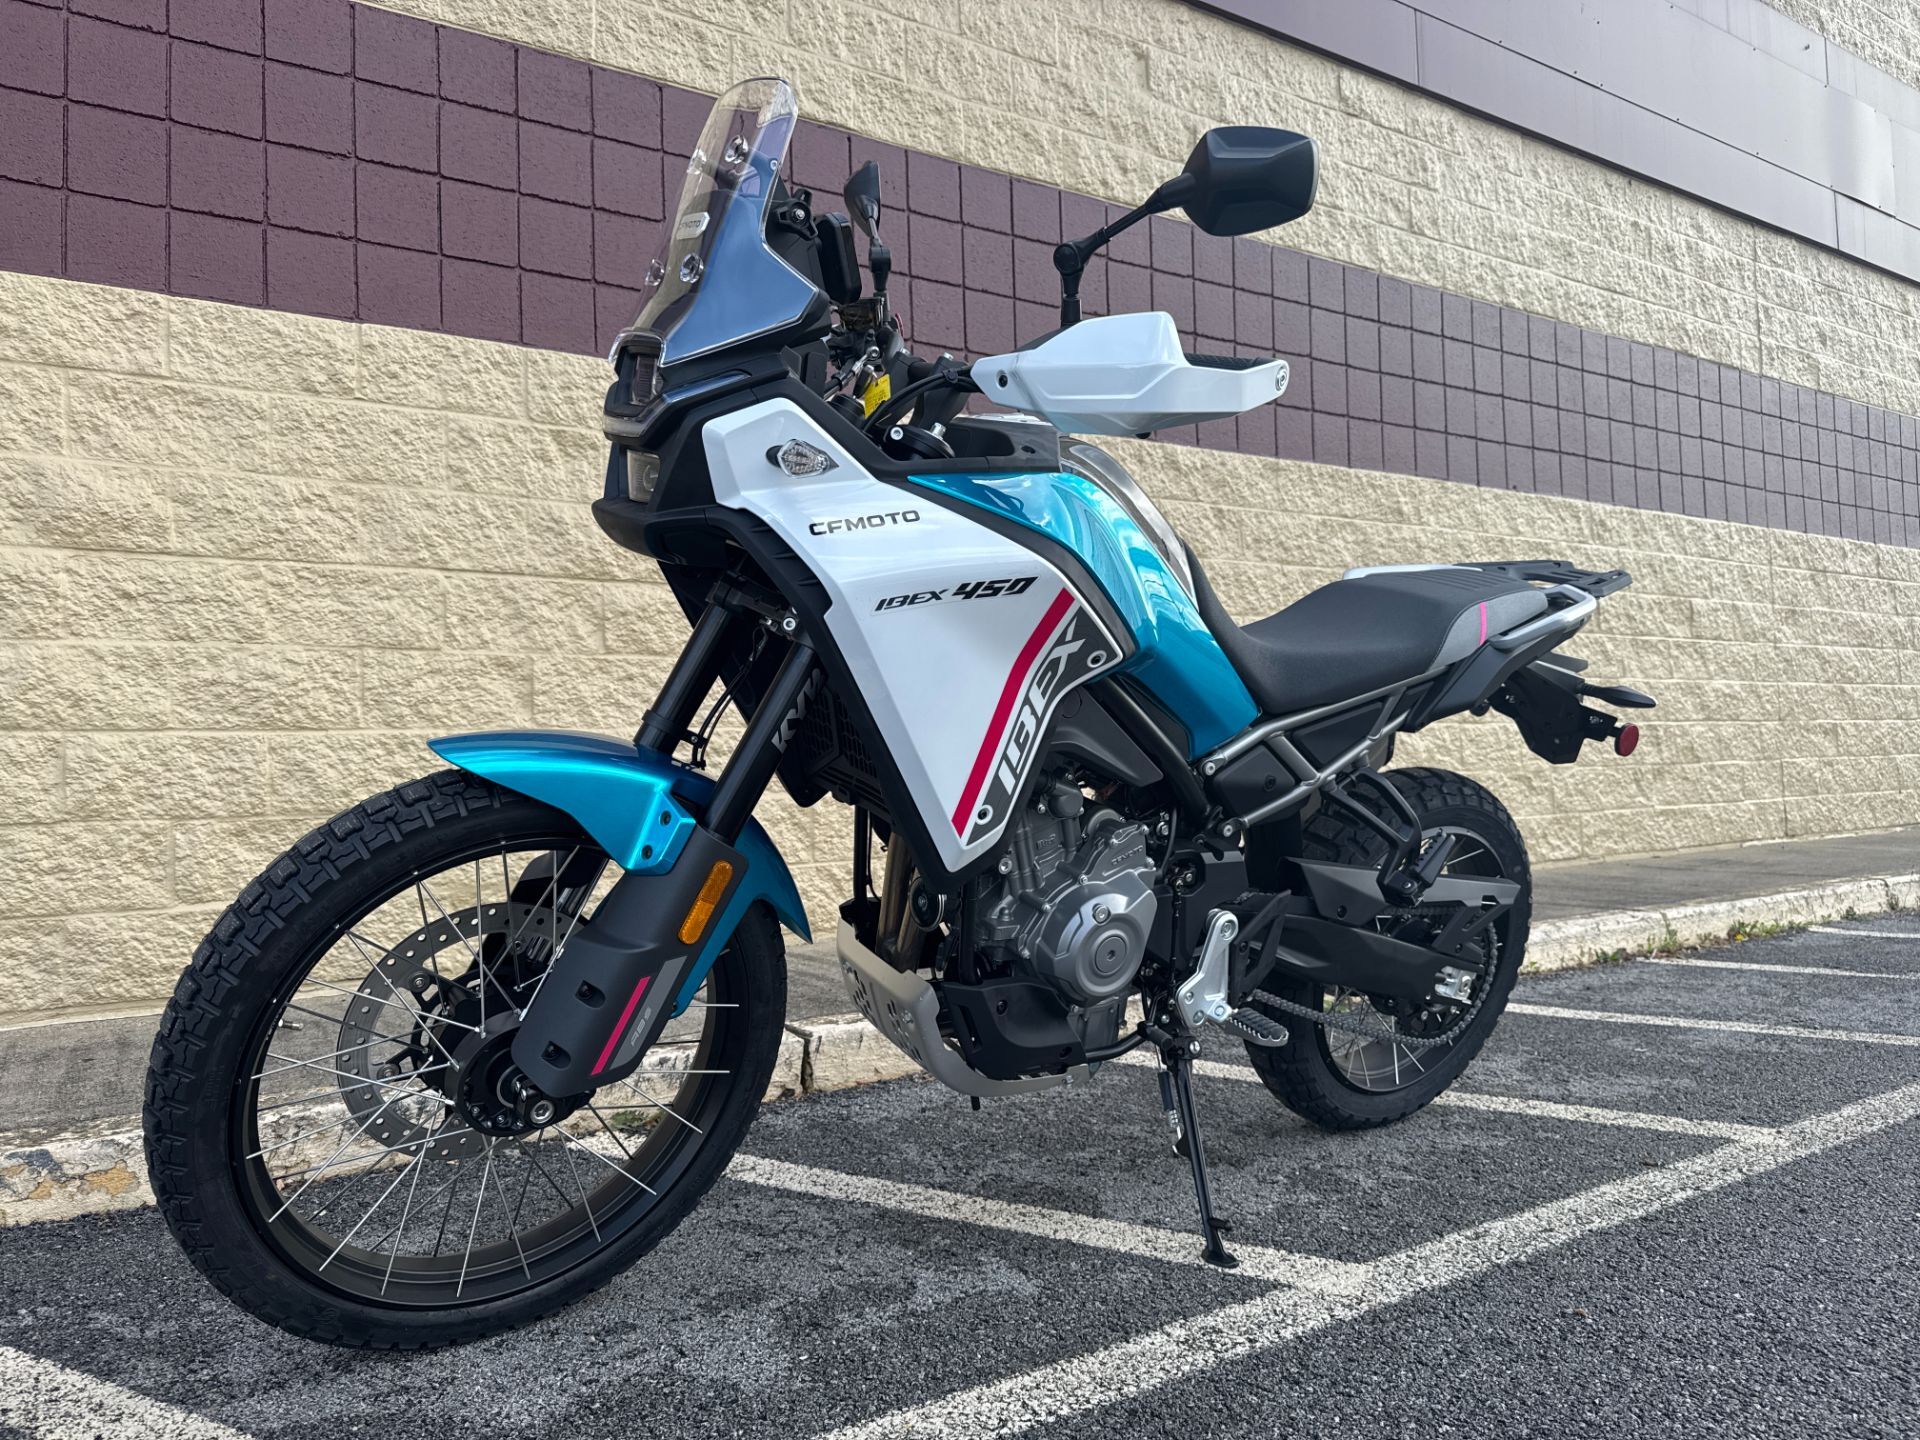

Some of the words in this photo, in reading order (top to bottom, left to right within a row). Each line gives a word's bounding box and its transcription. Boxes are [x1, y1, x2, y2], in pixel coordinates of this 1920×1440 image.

[808, 510, 921, 536] CFMOTO
[874, 589, 949, 612] IBEX
[951, 575, 1039, 600] 450
[998, 615, 1086, 795] IBEX
